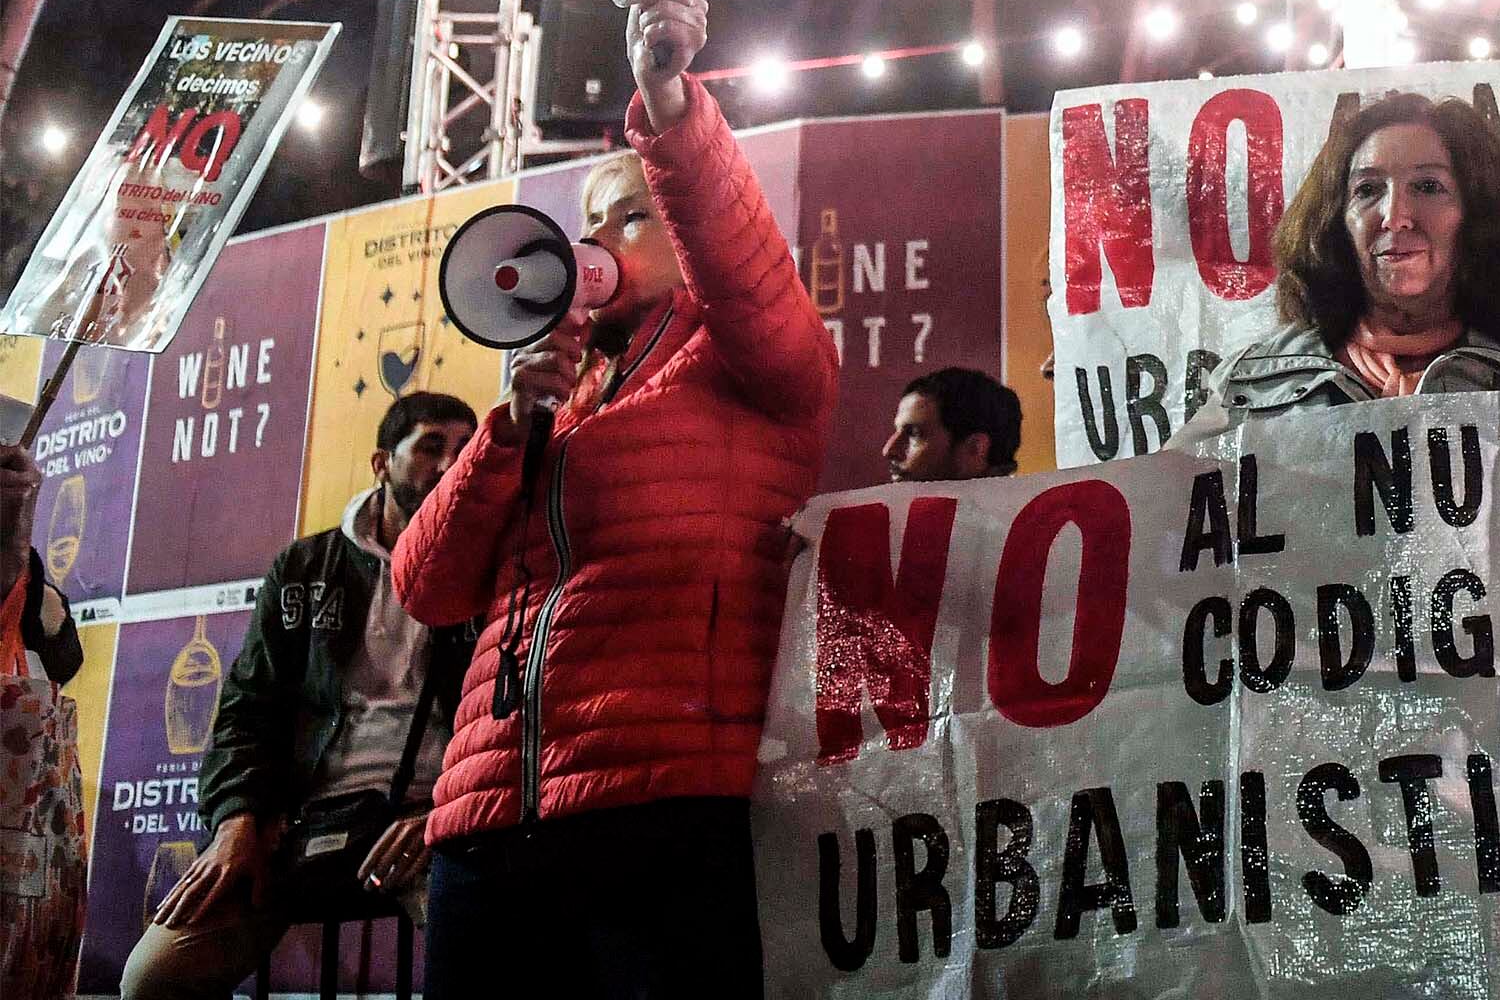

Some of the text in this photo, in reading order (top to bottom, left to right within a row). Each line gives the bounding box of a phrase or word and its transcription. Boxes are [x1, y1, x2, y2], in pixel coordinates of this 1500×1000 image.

[169, 40, 212, 60] LOS
[176, 73, 259, 96] decimos
[125, 103, 241, 182] NO
[136, 207, 172, 223] circo
[1062, 88, 1285, 316] NO
[35, 410, 126, 462] DISTRITO
[75, 443, 107, 469] VINO
[815, 477, 1132, 763] NO
[1179, 452, 1286, 573] AL
[132, 814, 169, 834] DEL
